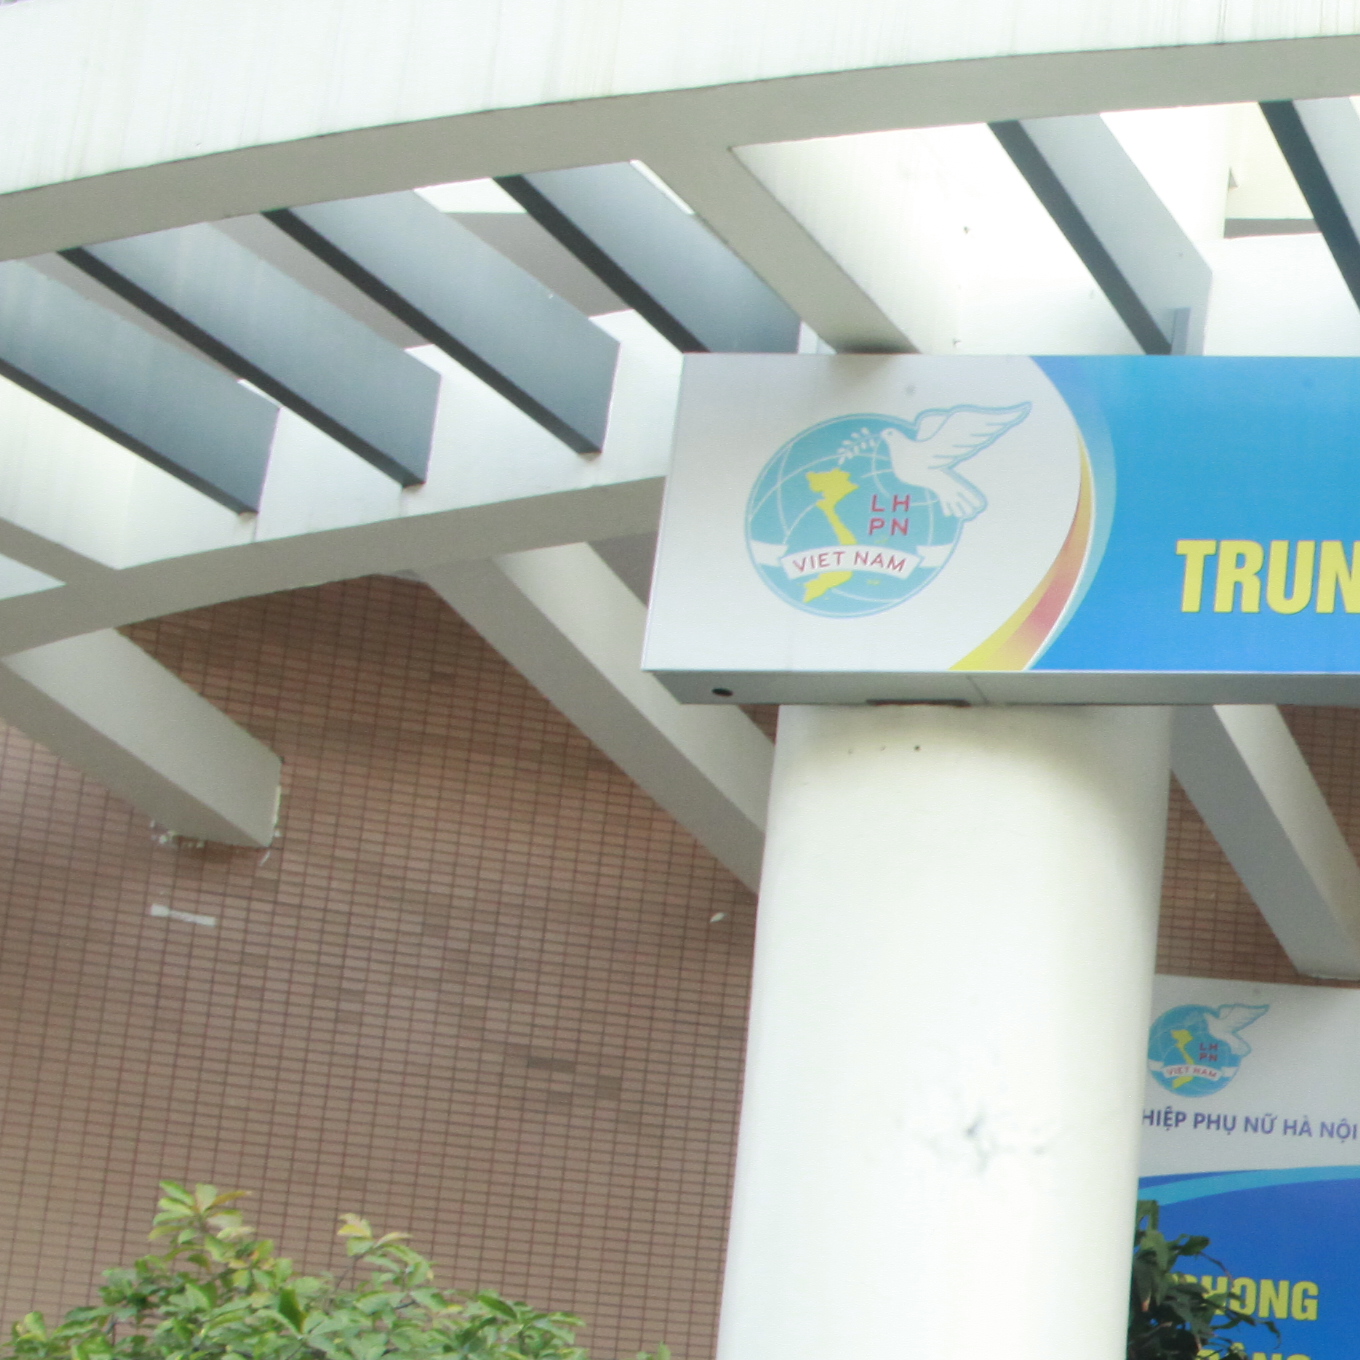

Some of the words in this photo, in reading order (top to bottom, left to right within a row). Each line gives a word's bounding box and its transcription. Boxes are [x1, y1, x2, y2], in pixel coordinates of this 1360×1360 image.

[792, 550, 846, 573] VIET
[853, 550, 907, 573] NAM
[1192, 1112, 1237, 1136] PHỤ
[1243, 1112, 1278, 1135] NỮ
[1282, 1114, 1313, 1138] HÀ
[1318, 1117, 1359, 1143] NỘI
